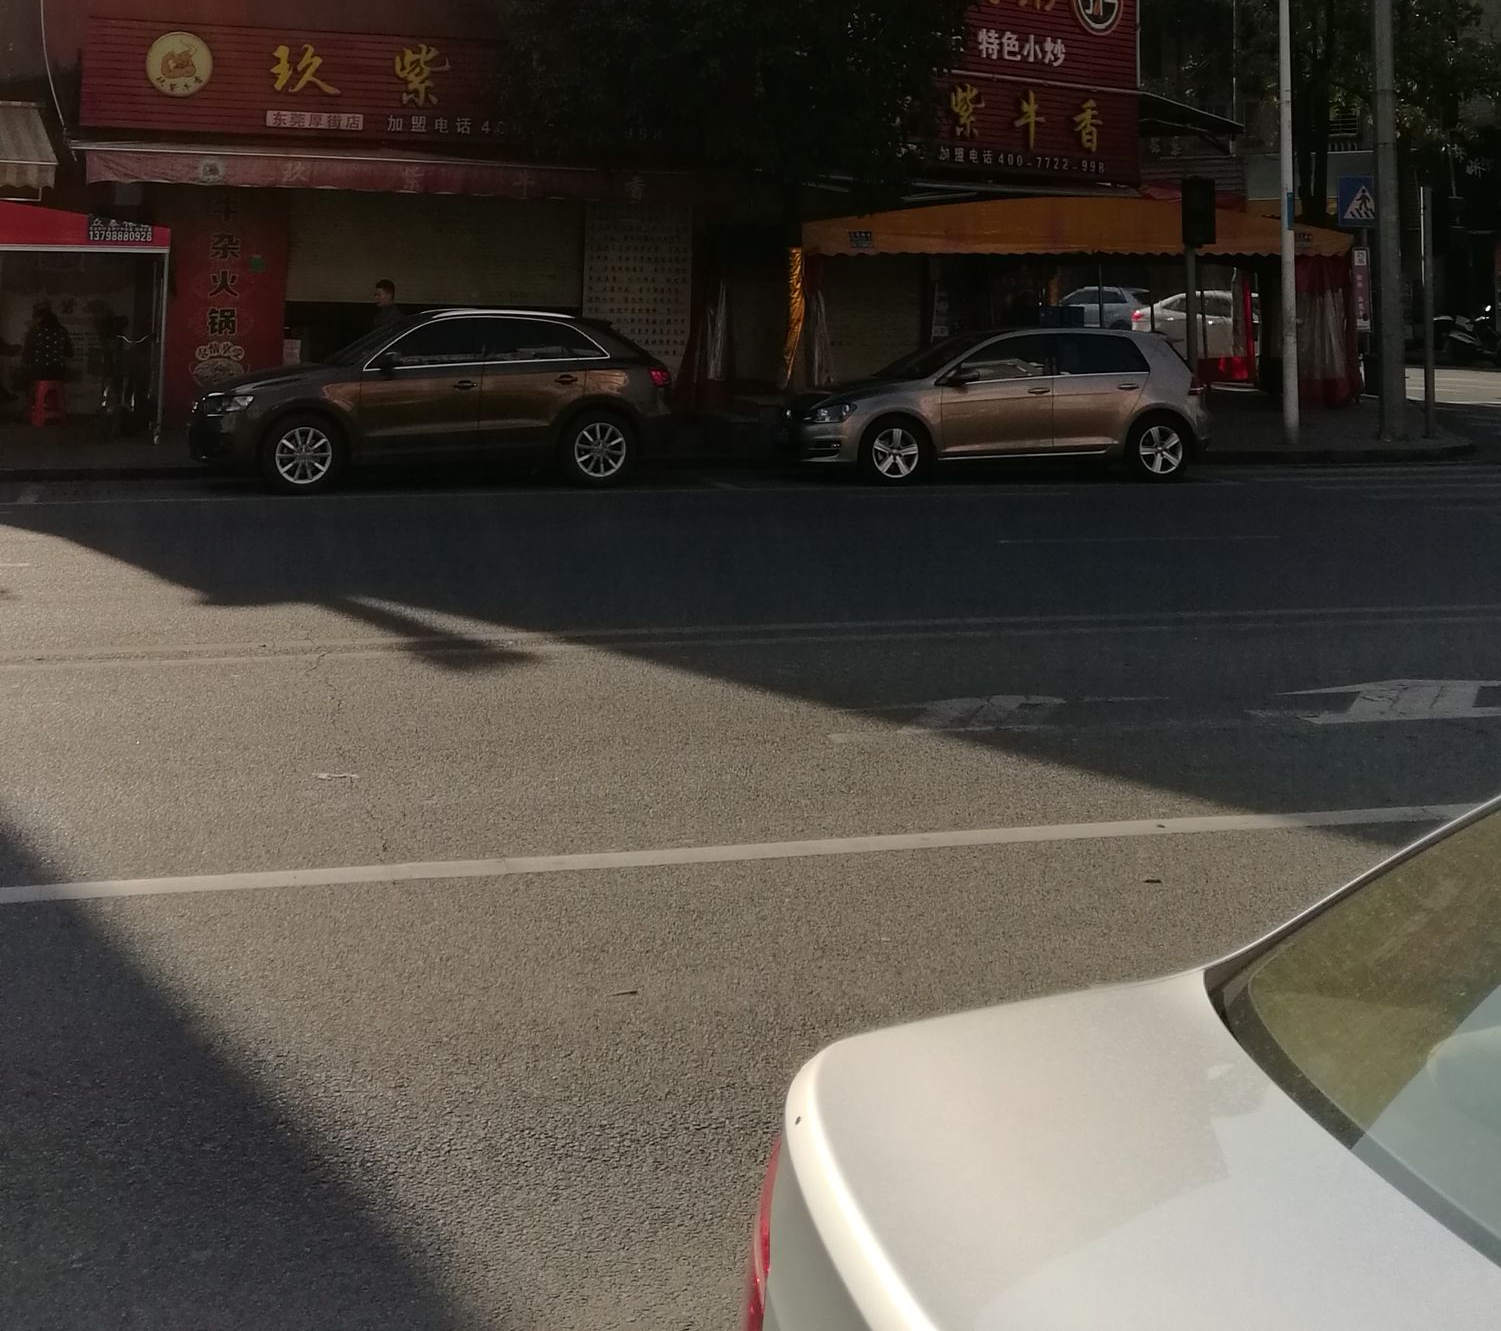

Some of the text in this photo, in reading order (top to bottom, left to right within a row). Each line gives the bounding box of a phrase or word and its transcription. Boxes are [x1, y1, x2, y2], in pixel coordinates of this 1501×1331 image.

[976, 28, 1066, 68] 特色小炒
[272, 111, 362, 131] 东莞厚街店
[88, 230, 153, 242] 13798880928
[207, 196, 241, 336] 牛杂火锅
